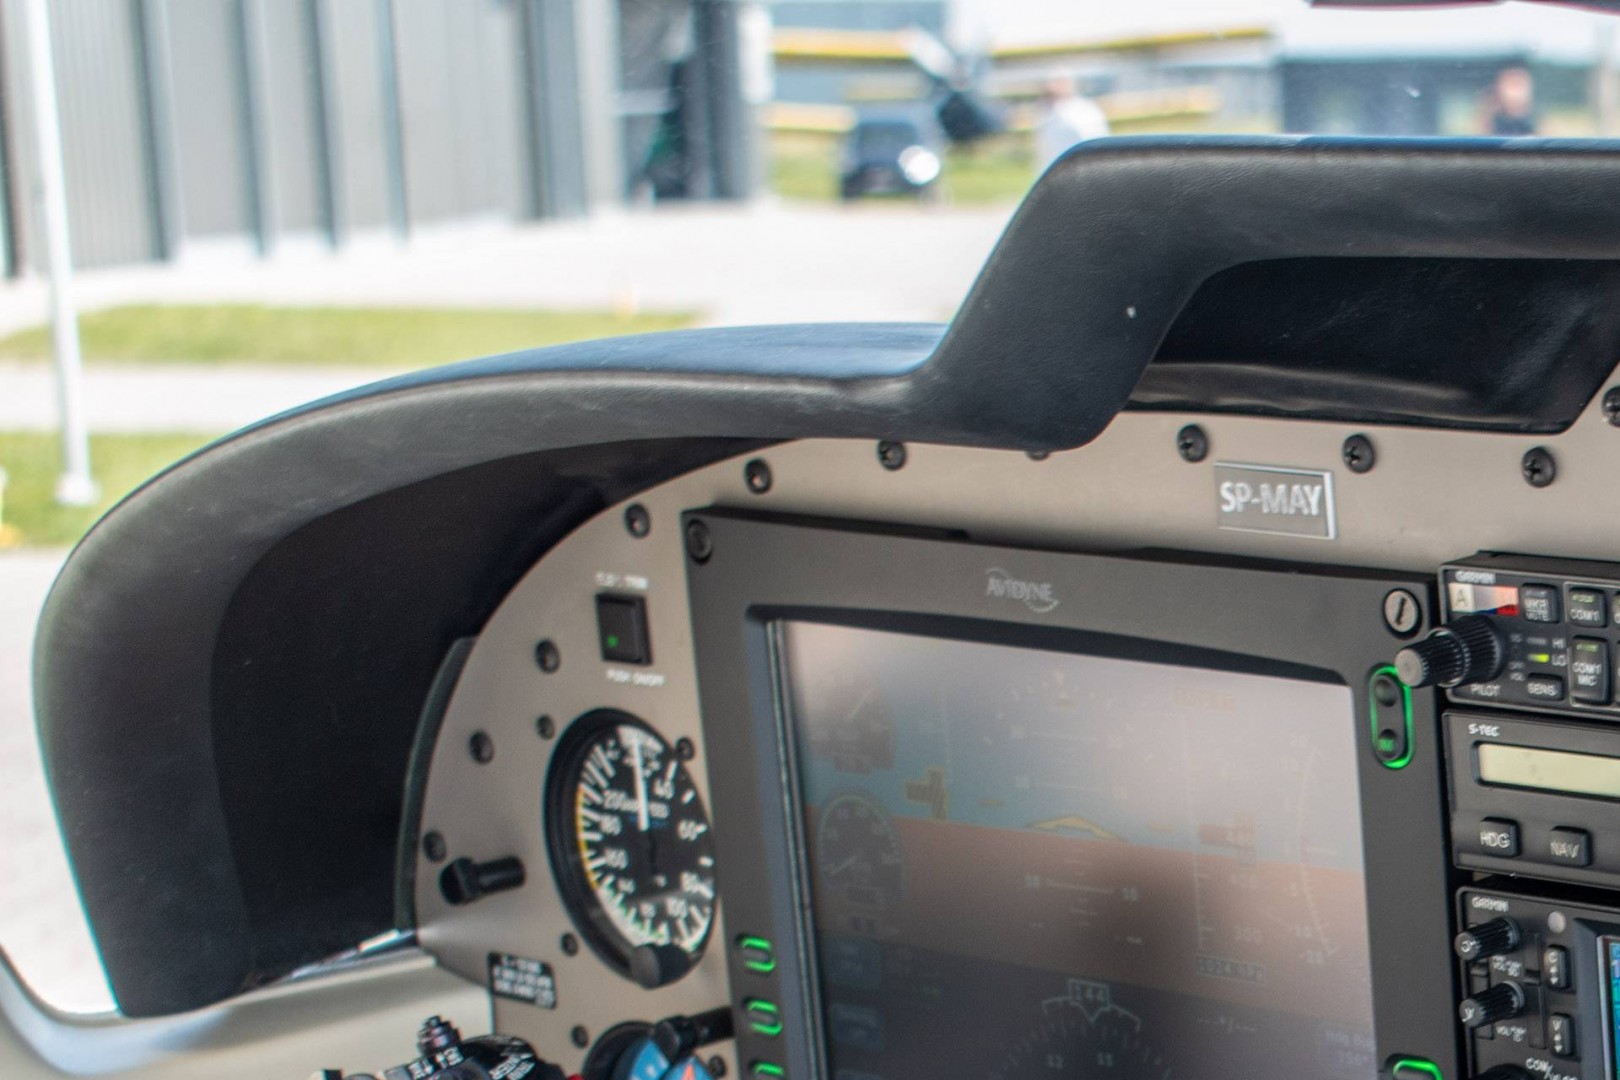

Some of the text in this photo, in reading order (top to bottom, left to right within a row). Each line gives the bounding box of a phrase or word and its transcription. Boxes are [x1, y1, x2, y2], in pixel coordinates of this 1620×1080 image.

[1220, 481, 1323, 515] SP-MAY
[1570, 609, 1600, 621] COM1
[1573, 663, 1601, 675] COM1
[1480, 830, 1510, 848] HDG
[1551, 840, 1580, 858] NAV
